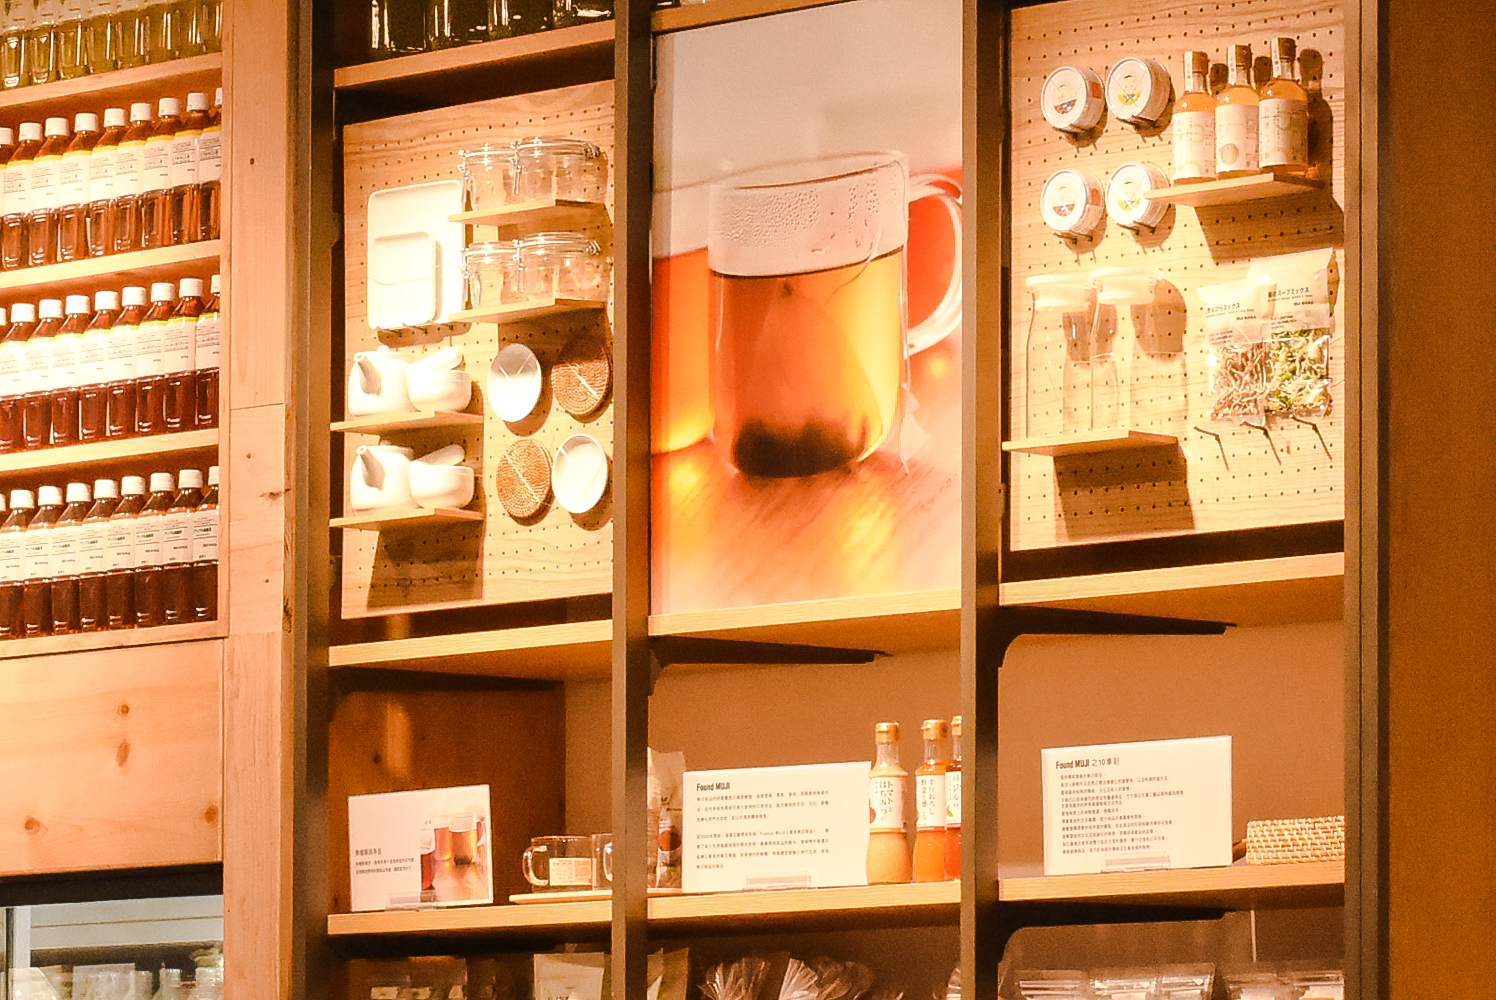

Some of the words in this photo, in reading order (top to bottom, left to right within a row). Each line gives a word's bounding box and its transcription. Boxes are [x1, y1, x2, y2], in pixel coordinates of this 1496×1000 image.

[1056, 761, 1074, 770] Found
[1075, 759, 1090, 768] MUJI
[697, 783, 715, 792] Found
[716, 782, 731, 791] MUJI
